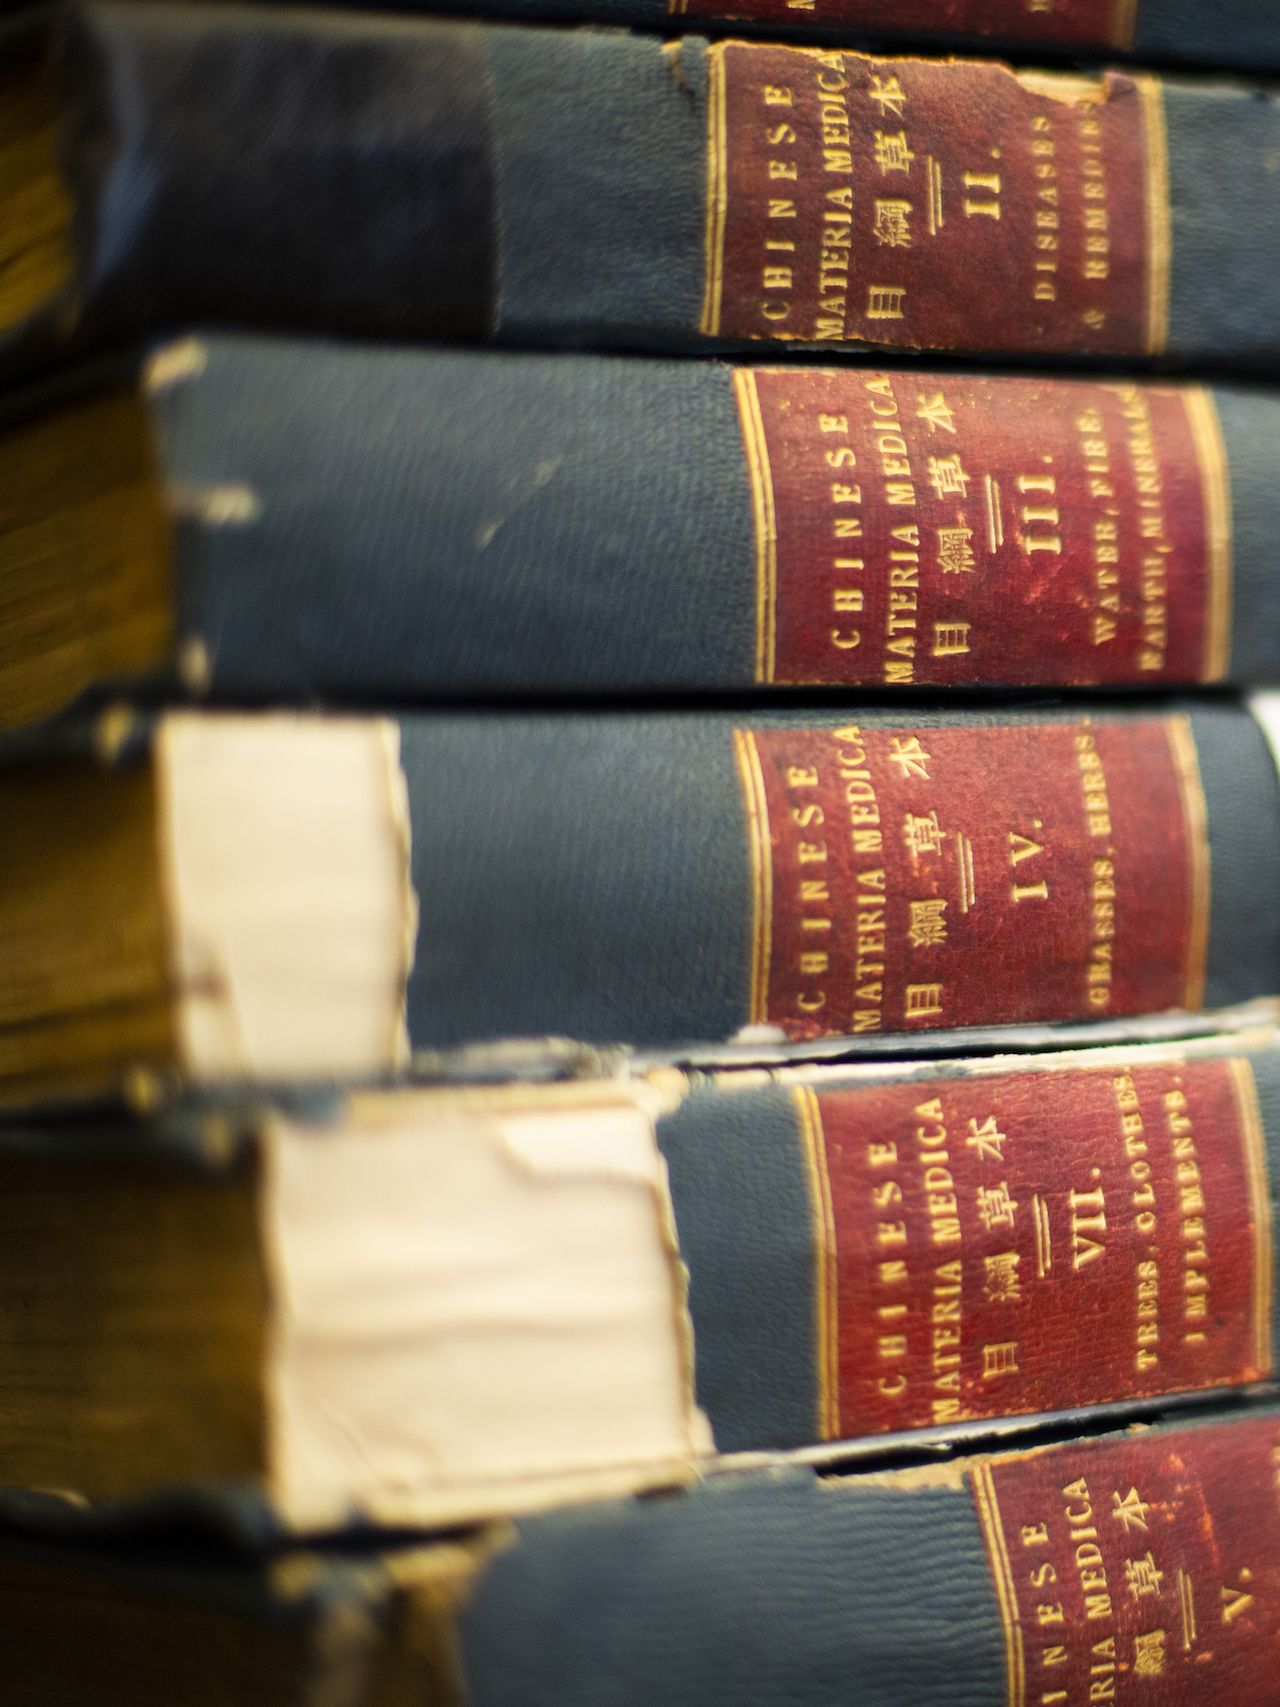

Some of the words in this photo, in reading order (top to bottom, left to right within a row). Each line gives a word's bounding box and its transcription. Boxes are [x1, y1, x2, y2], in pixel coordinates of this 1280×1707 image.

[814, 53, 853, 173] MEDICA
[964, 145, 1003, 220] II.
[761, 84, 800, 320] CHINESE
[815, 188, 853, 340] MATERIA
[867, 75, 916, 321] 本草綱目
[1030, 114, 1058, 301] DISEASES
[863, 376, 916, 505] MEDICA
[1018, 455, 1062, 555] III.
[818, 412, 865, 650] CHINESE
[884, 524, 921, 684] MATERIA
[915, 391, 976, 657] 本草綱目
[833, 725, 884, 853] MEDICA
[786, 764, 832, 1012] CHINESE
[853, 869, 887, 1033] MATERIA
[890, 735, 948, 1019] 本草綱目
[914, 1097, 961, 1243] MEDICA
[966, 1115, 1022, 1380] 本草綱目
[1070, 1167, 1108, 1269] VII.
[868, 1140, 909, 1396] CHINESE
[930, 1259, 963, 1422] MATERIA
[1061, 1476, 1113, 1619] MEDICA
[1221, 1566, 1255, 1624] V.
